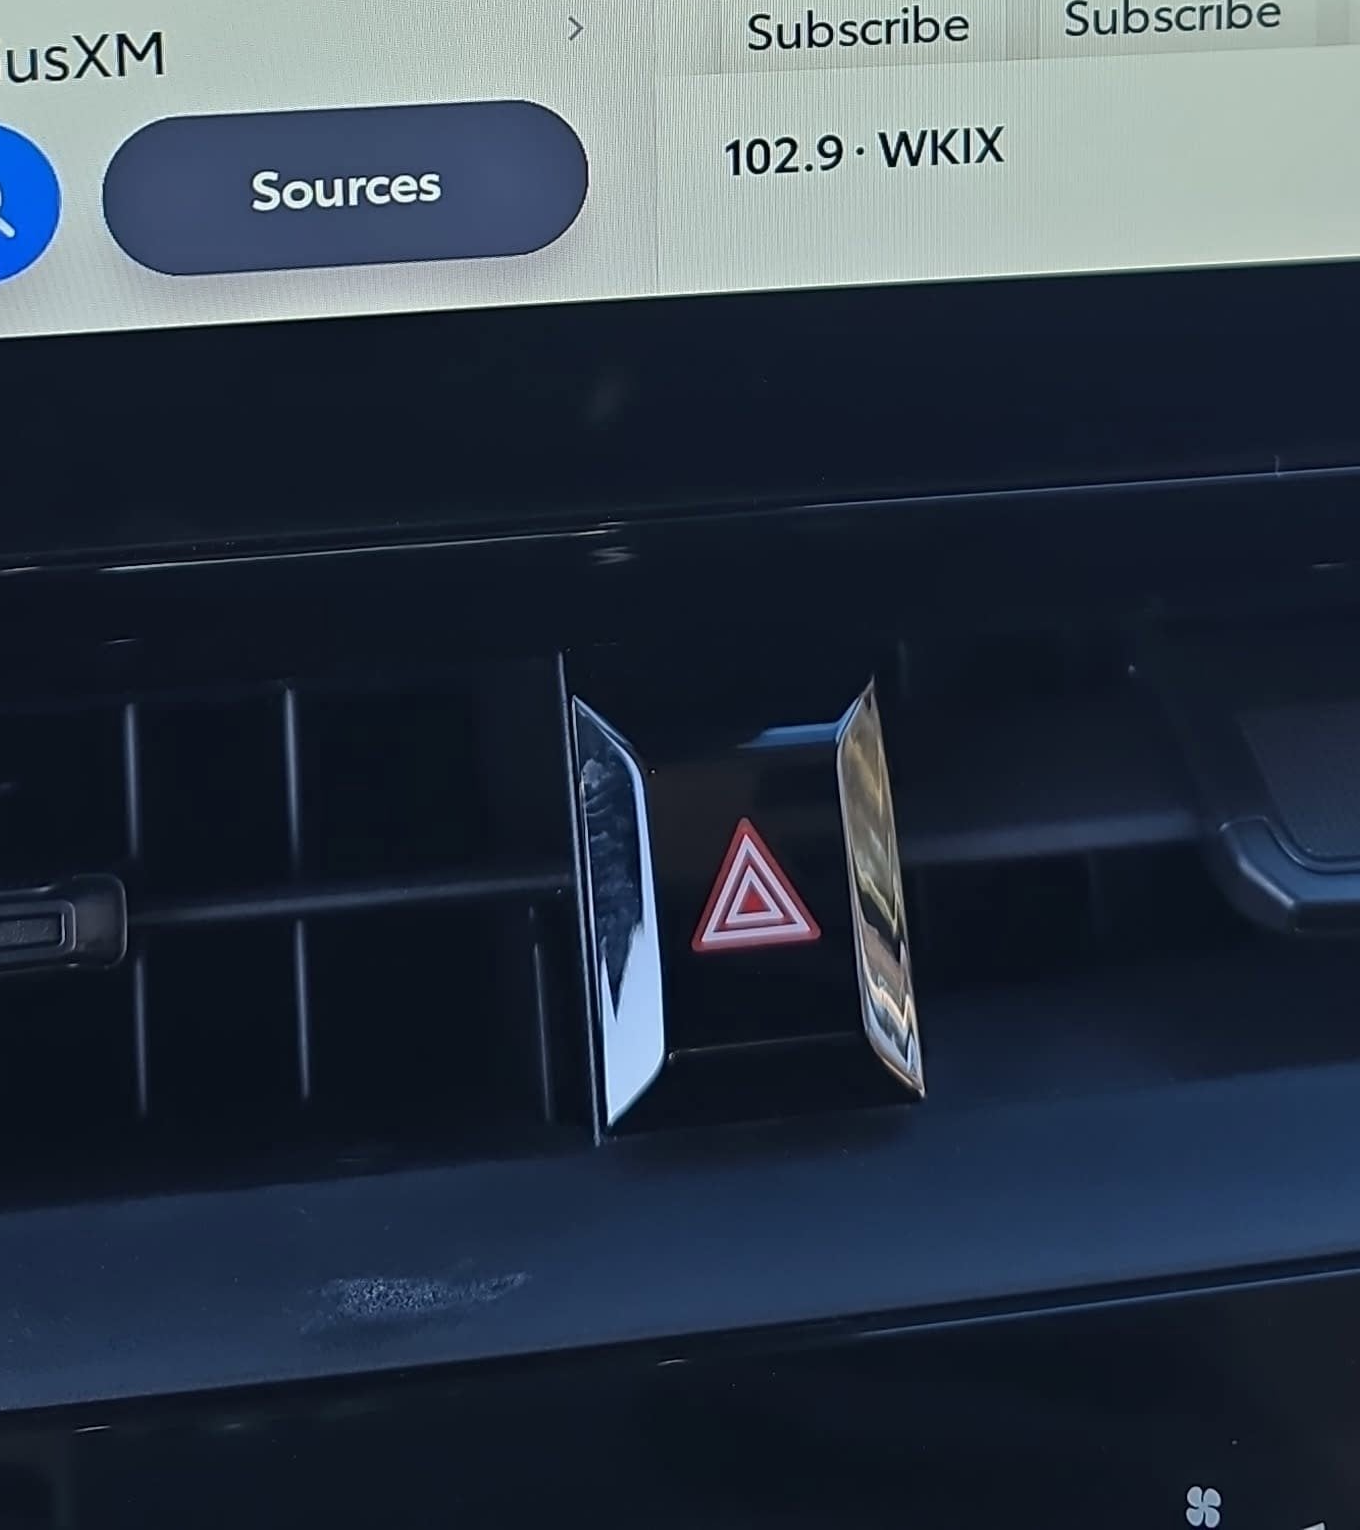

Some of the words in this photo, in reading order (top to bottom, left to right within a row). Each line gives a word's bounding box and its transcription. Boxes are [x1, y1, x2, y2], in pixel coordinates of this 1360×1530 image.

[749, 6, 969, 50] Subscribe
[726, 135, 843, 175] 102.9
[879, 127, 1003, 167] WKIX
[253, 172, 440, 210] Sources
